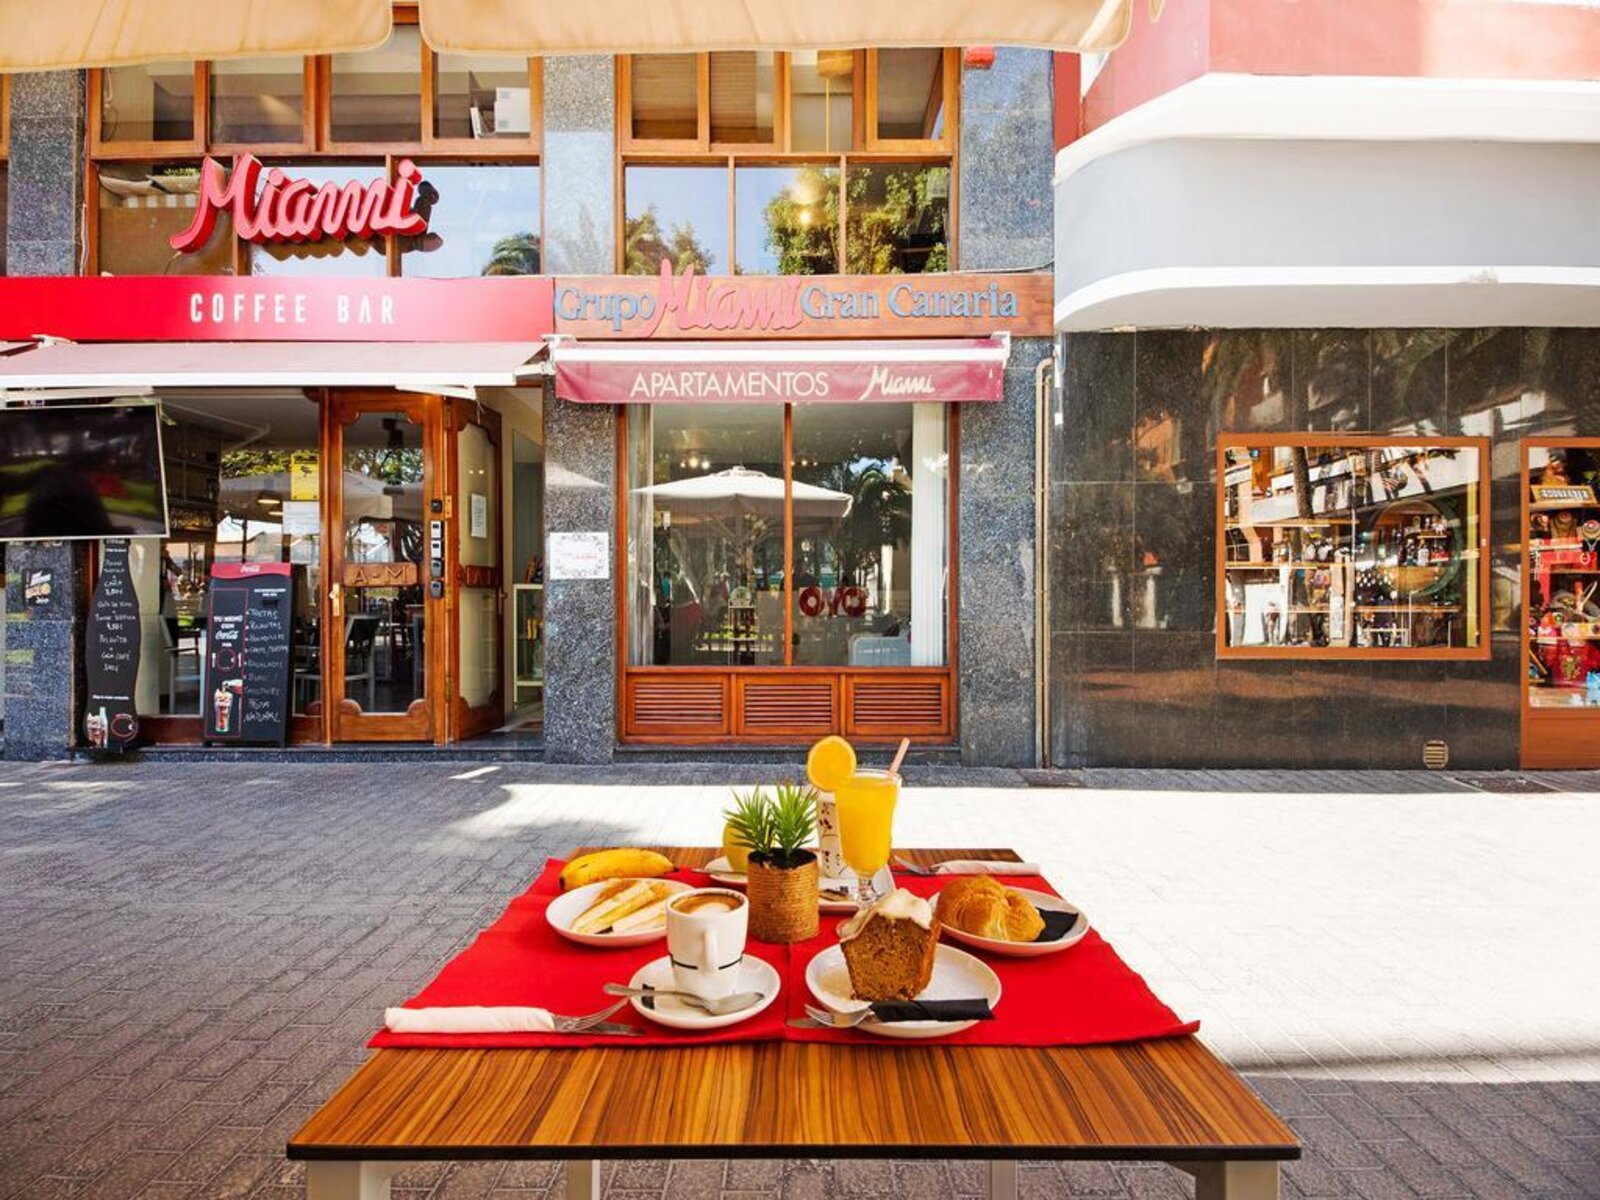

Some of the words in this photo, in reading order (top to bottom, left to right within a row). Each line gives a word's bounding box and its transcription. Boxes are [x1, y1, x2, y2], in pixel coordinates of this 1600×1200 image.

[169, 153, 427, 254] Miami
[190, 293, 306, 323] COFFEE
[337, 295, 395, 324] BAR
[555, 287, 656, 331] Grupo
[640, 258, 802, 338] Miami
[800, 284, 880, 319] Gran
[888, 282, 1019, 318] Canaria
[630, 371, 829, 397] APARTAMENTOS
[859, 365, 935, 401] Miami
[799, 586, 867, 617] OYO
